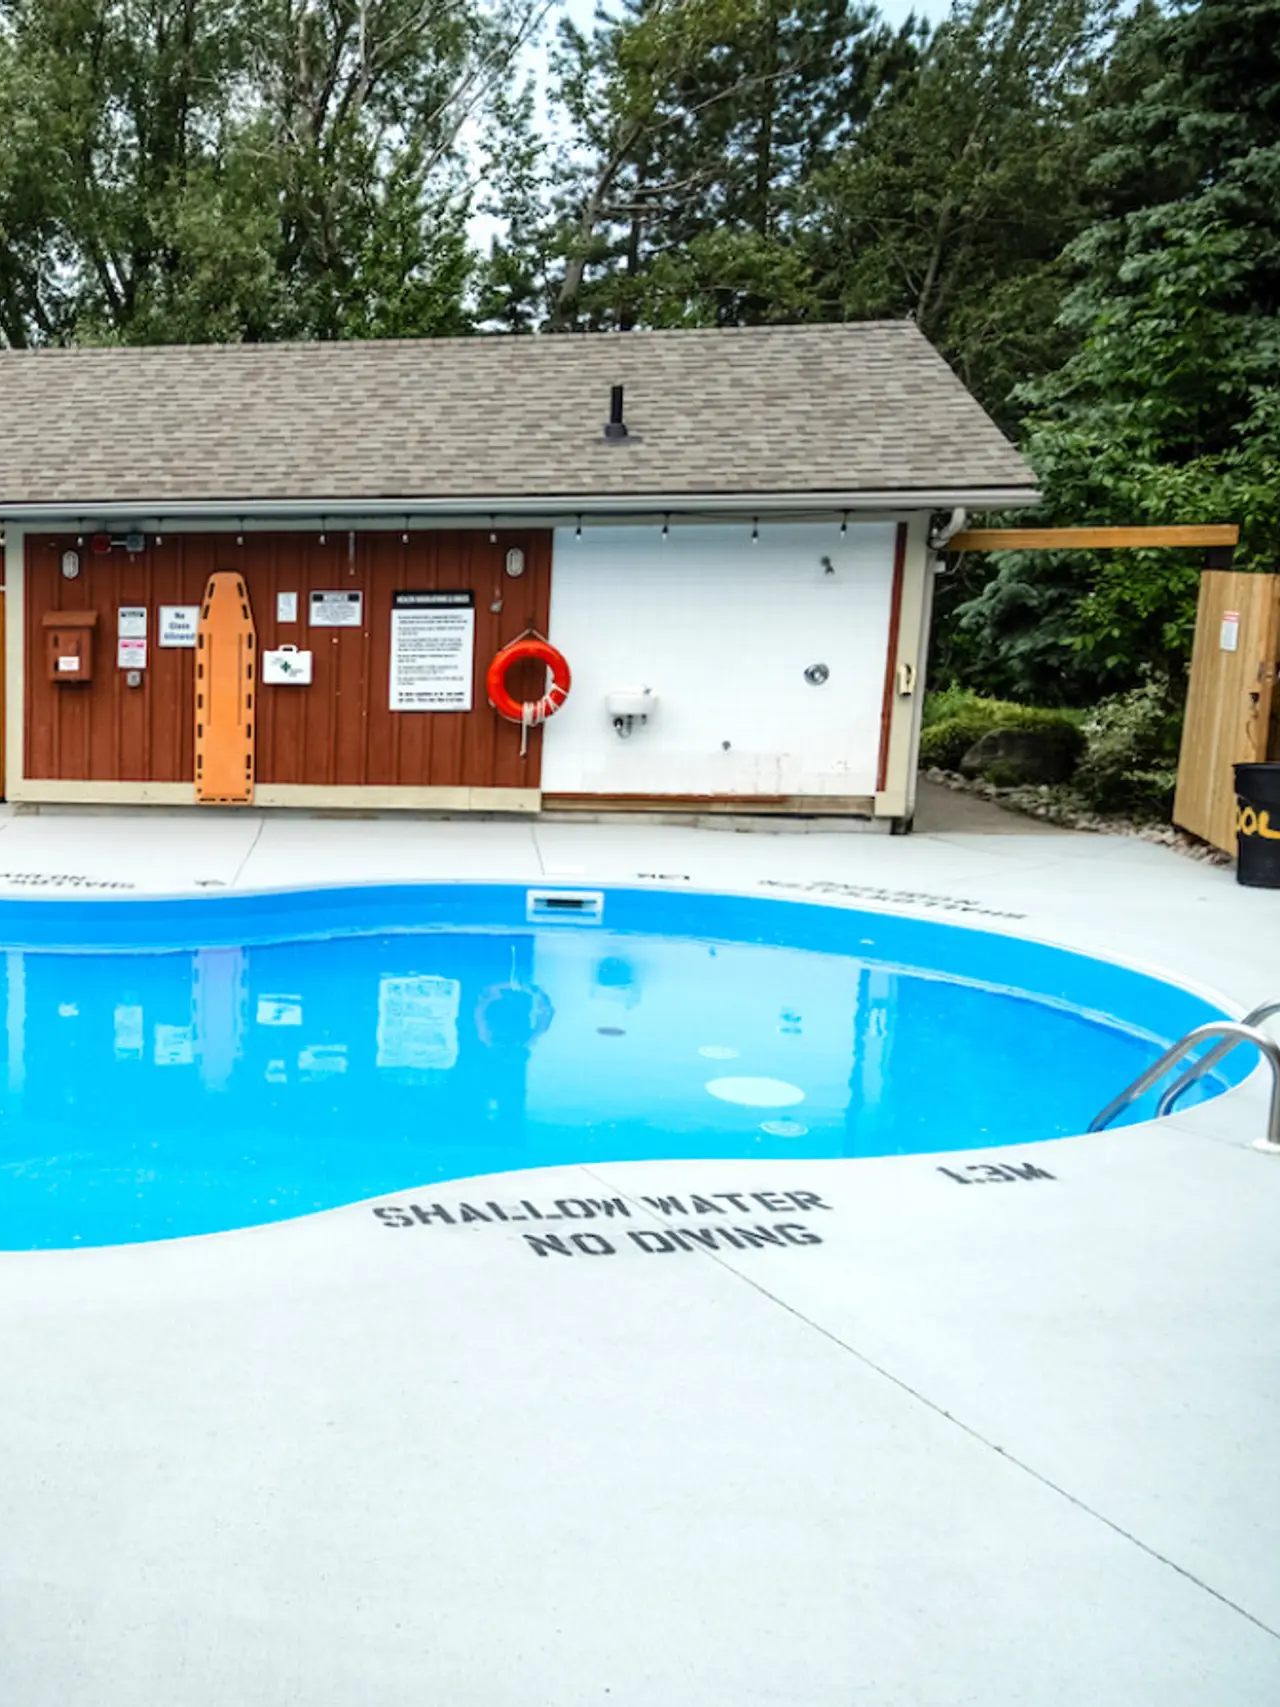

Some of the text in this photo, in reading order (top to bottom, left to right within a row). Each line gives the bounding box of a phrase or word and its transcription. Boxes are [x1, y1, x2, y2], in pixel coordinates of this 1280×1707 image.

[1236, 807, 1280, 839] OL
[372, 1190, 834, 1228] SHALLOW WATER
[521, 1222, 825, 1258] NO DIVING
